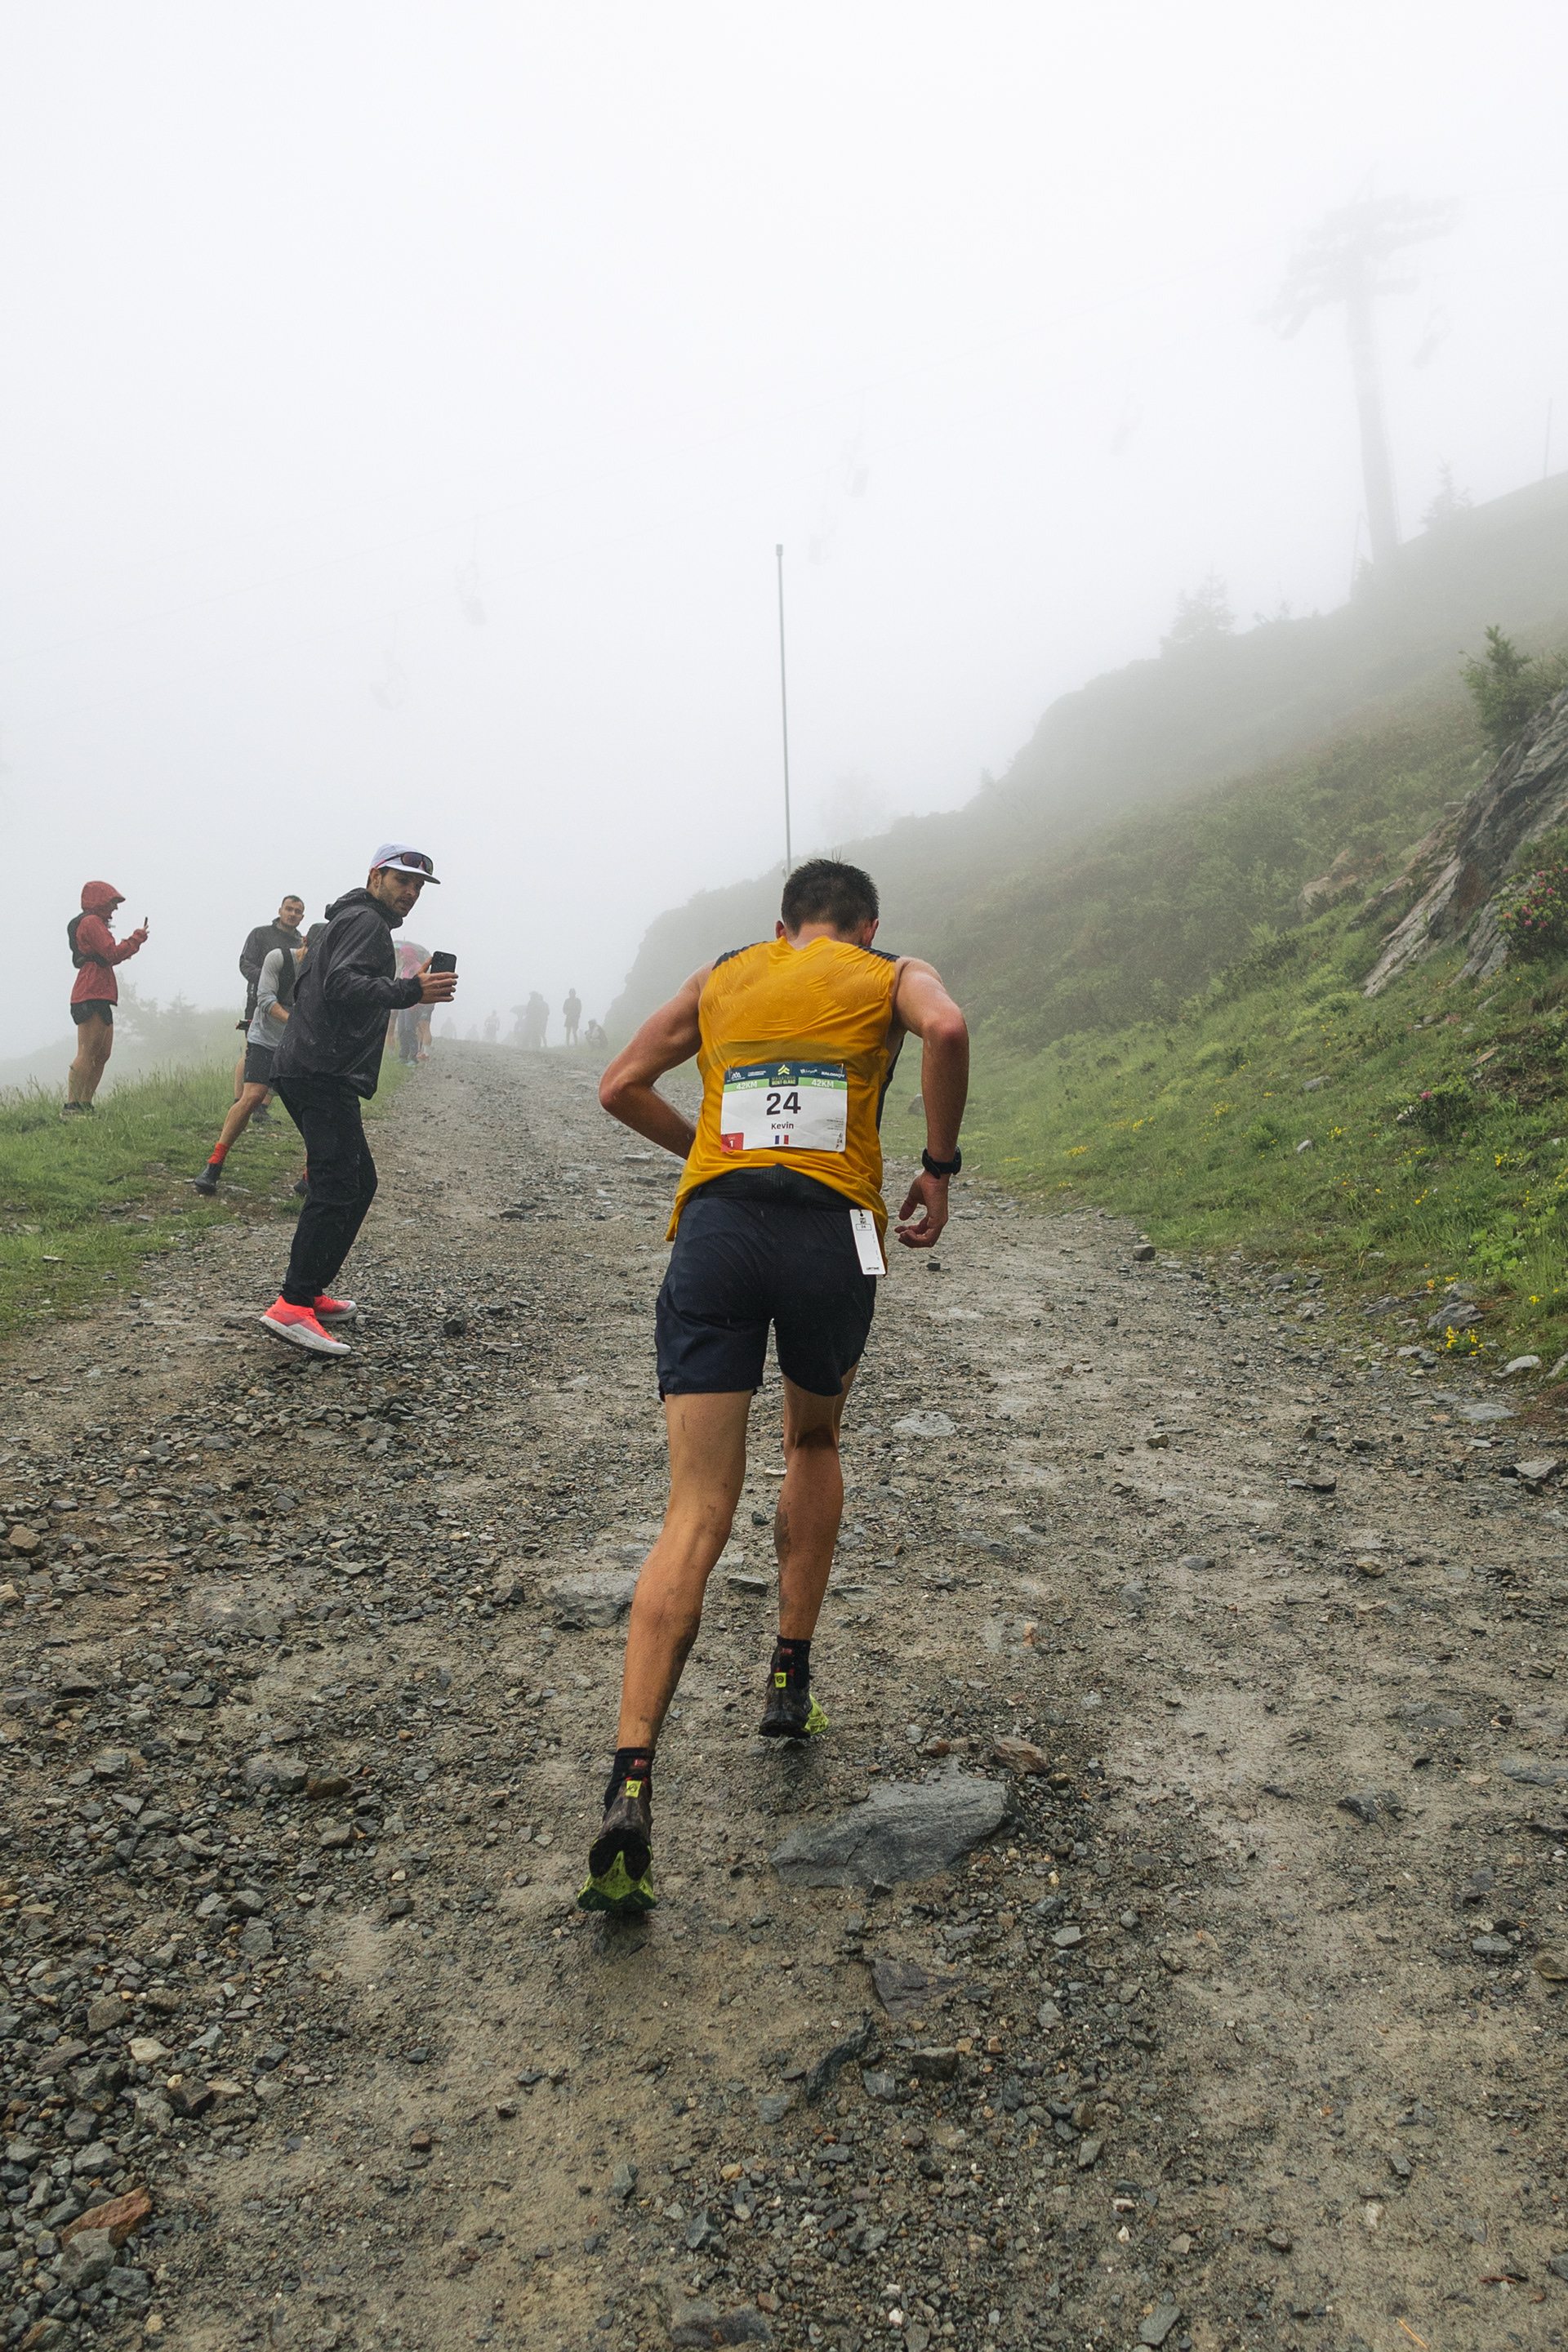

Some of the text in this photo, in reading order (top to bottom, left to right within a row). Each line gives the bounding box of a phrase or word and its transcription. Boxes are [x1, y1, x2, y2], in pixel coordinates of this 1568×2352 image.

[737, 1081, 757, 1089] 42KM
[812, 1079, 833, 1088] 42KM
[766, 1092, 801, 1116] 24
[771, 1121, 795, 1130] Kevin
